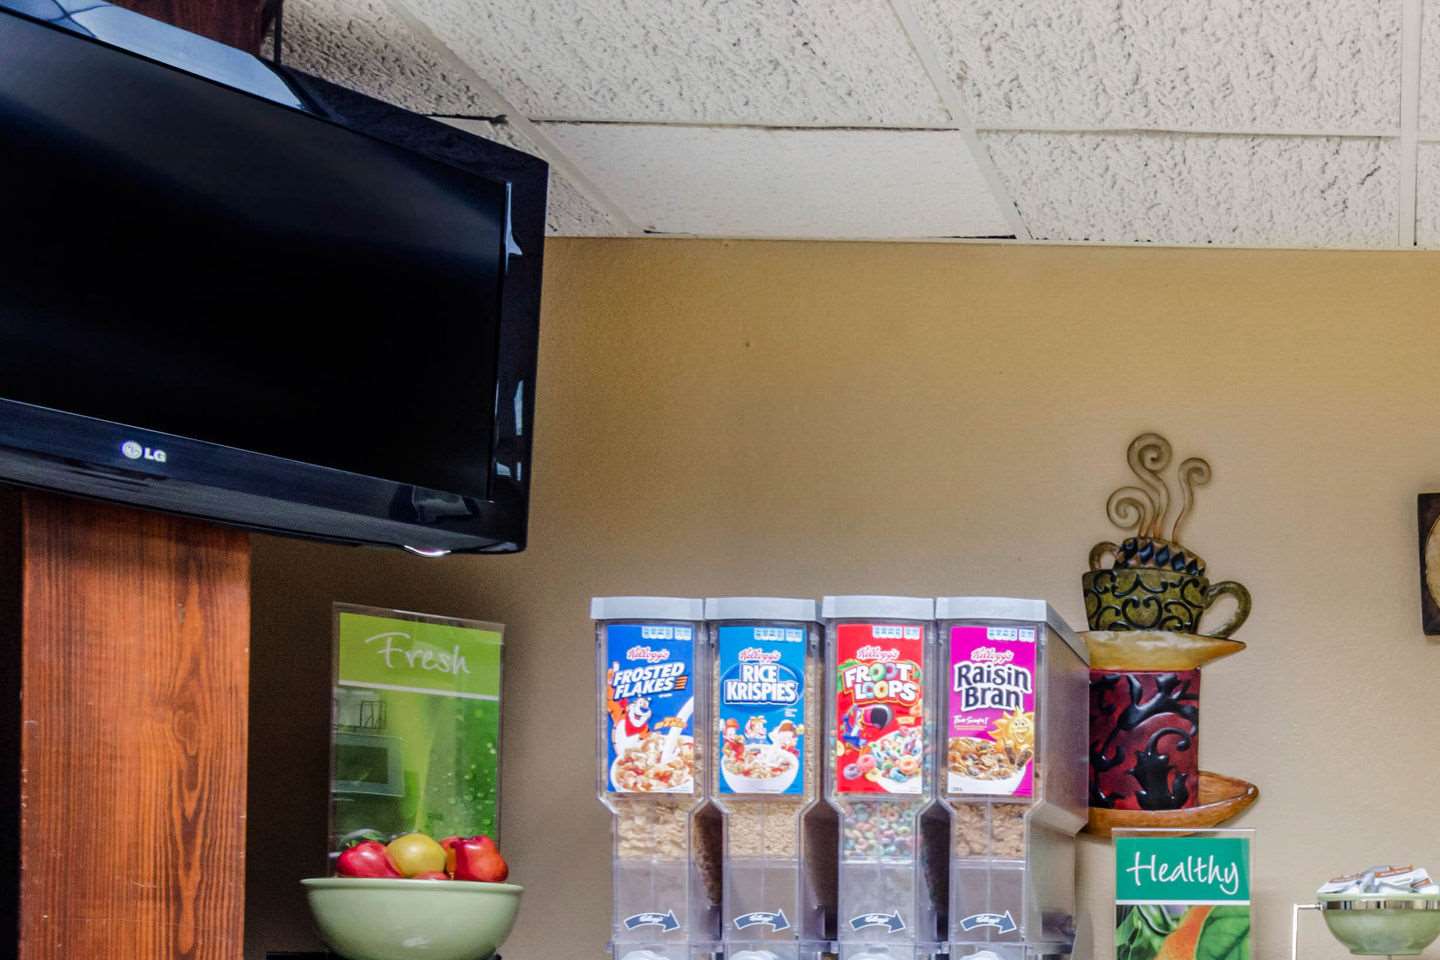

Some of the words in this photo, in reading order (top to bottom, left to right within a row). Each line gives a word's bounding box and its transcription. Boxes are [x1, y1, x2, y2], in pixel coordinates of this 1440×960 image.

[144, 447, 167, 463] LG
[365, 631, 471, 675] Fresh
[613, 662, 686, 688] FROSTED
[742, 664, 778, 683] RICE
[845, 663, 913, 688] FROOT
[956, 663, 1029, 691] Raisin
[614, 677, 676, 700] FLAKES
[726, 682, 798, 702] KRISPIES
[855, 680, 917, 700] LOOPS
[963, 685, 1022, 709] Bran
[1126, 851, 1239, 895] Healthy
